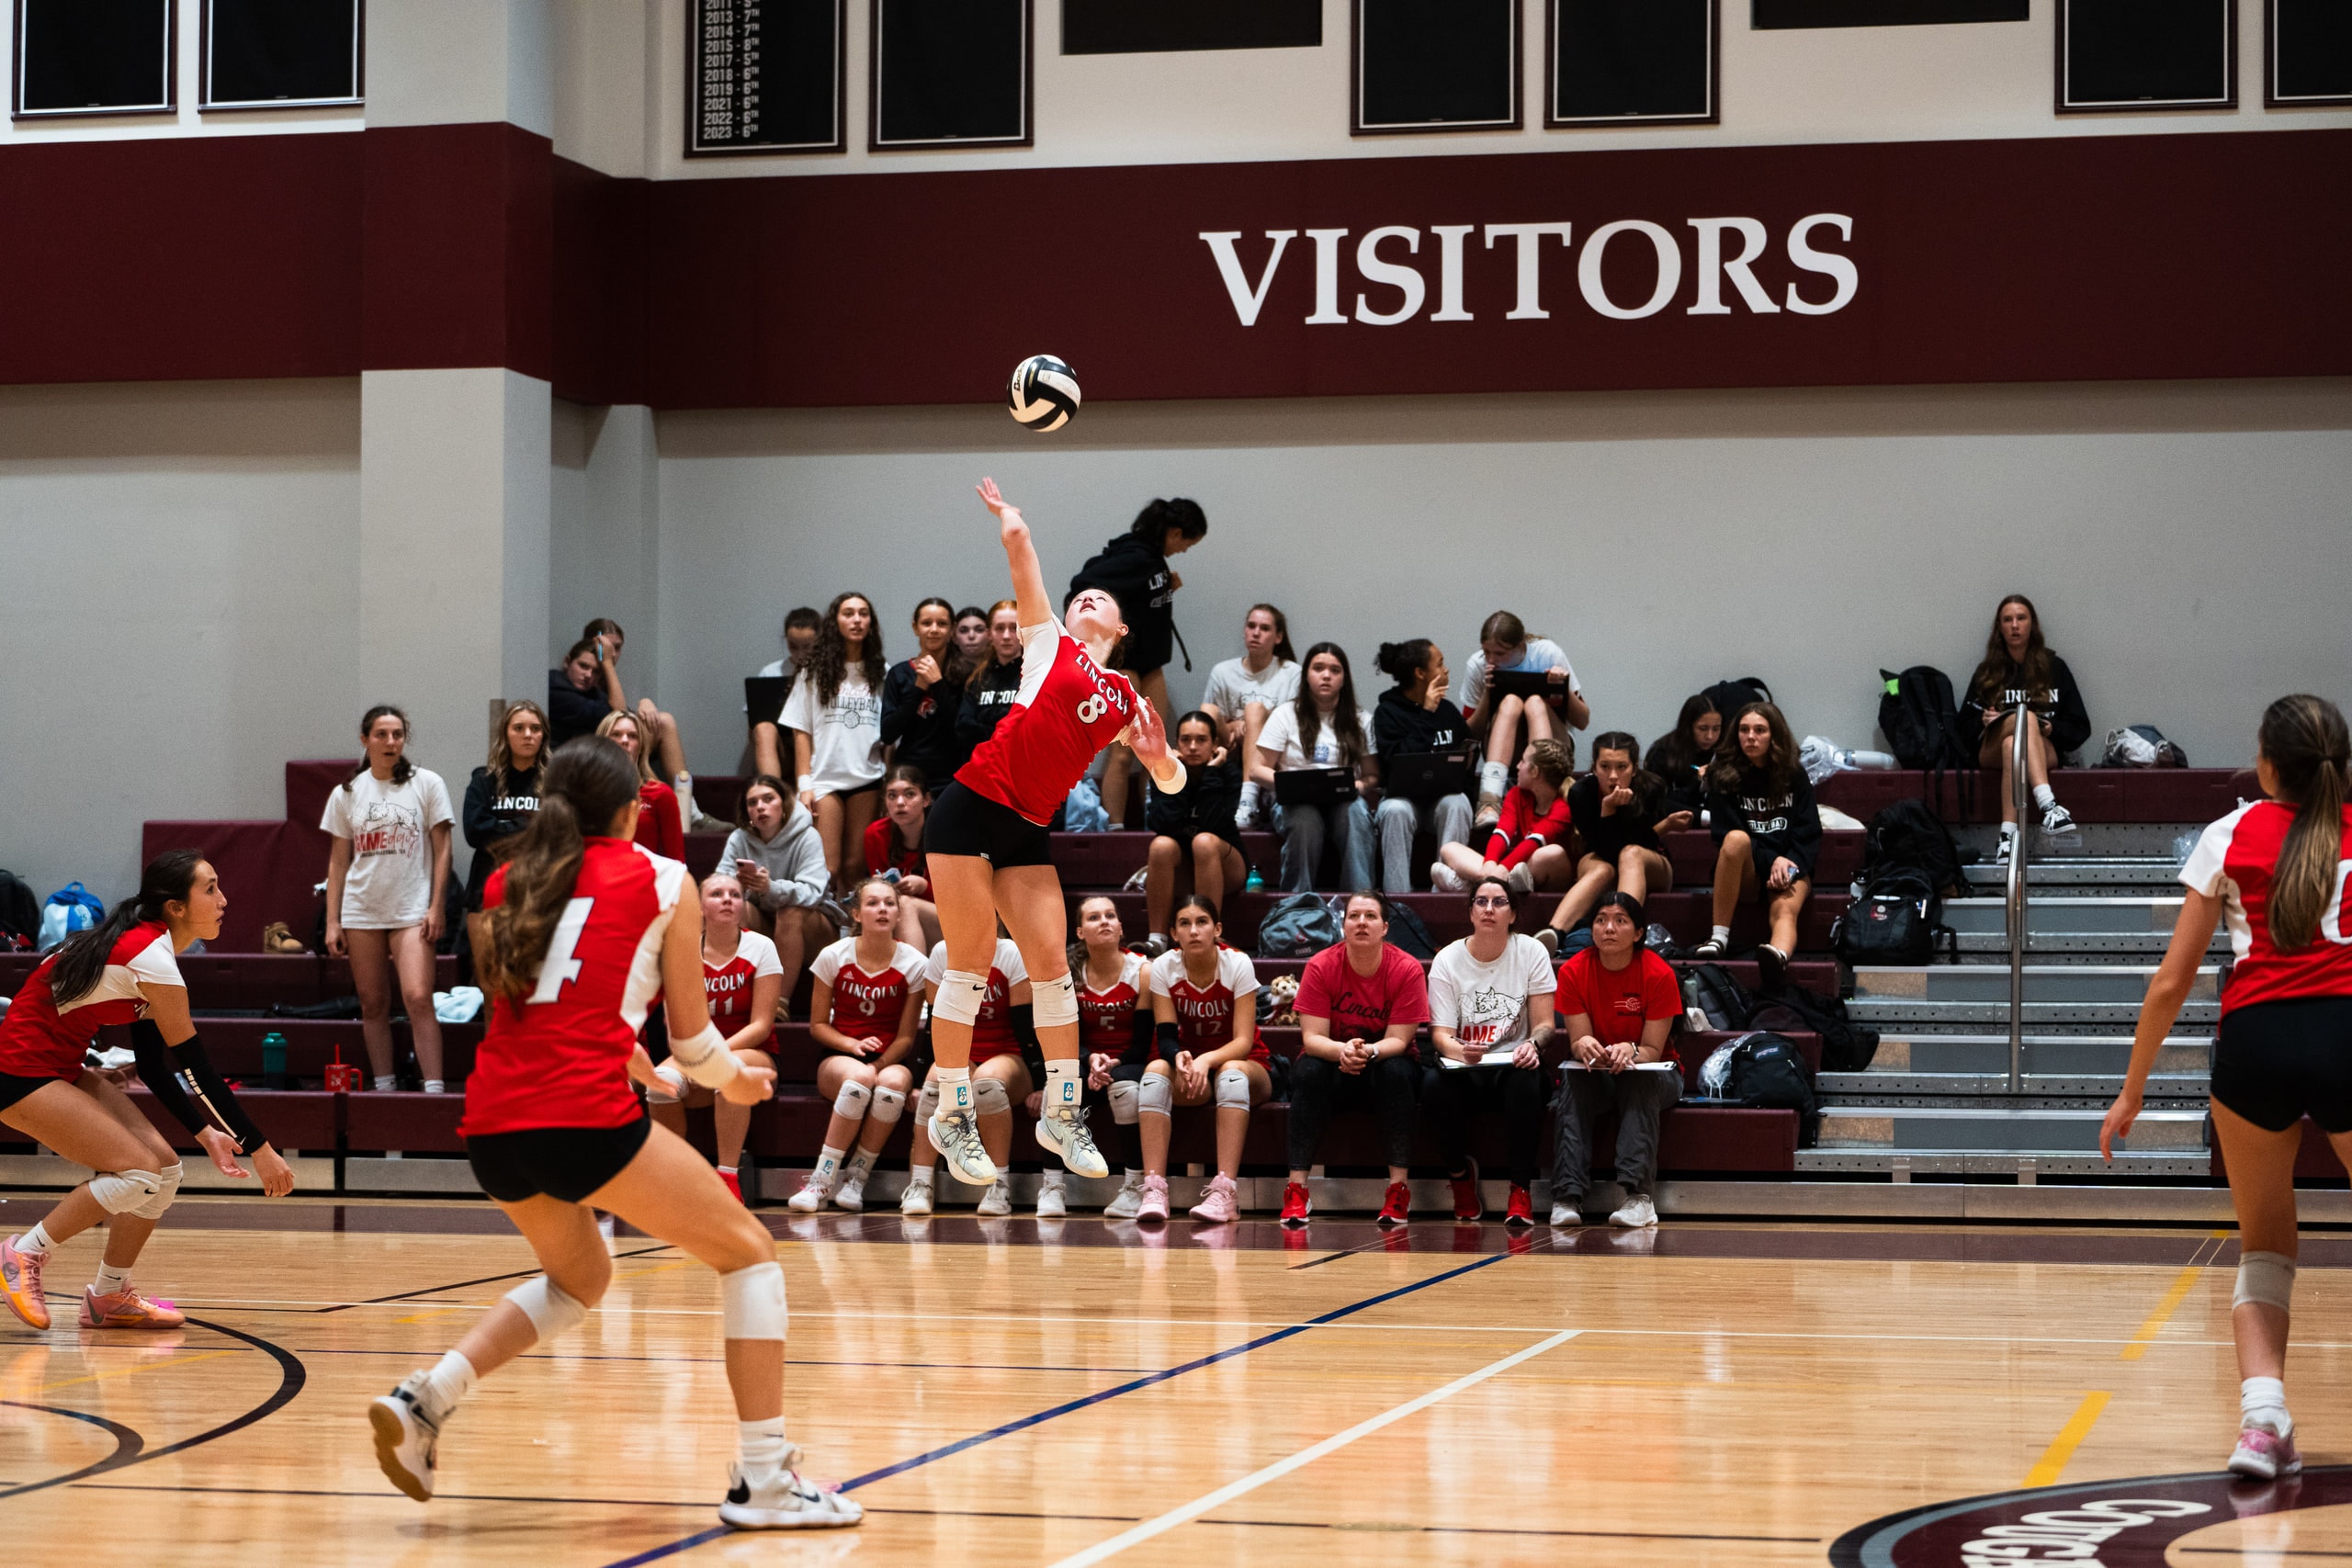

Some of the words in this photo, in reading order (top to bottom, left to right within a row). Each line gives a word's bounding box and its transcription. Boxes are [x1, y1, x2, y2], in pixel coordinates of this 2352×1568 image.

[706, 11, 733, 24] 2013
[744, 8, 760, 23] 7TH
[706, 26, 733, 39] 2014
[744, 23, 760, 37] 7TH
[706, 39, 733, 53] 2015
[744, 38, 760, 51] 8TH
[705, 54, 733, 68] 2017
[744, 51, 760, 66] 5TH
[705, 69, 733, 83] 2018
[743, 66, 760, 80] 6TH
[705, 83, 733, 96] 2019
[743, 81, 760, 95] 6TH
[705, 97, 732, 111] 2021
[743, 96, 760, 109] 6TH
[705, 111, 733, 126] 2022
[743, 109, 759, 124] 6TH
[704, 126, 733, 140] 2023
[742, 124, 759, 138] 6TH
[1199, 212, 1859, 326] VISITORS
[1077, 693, 1108, 724] 8
[707, 996, 733, 1017] 11
[859, 999, 876, 1016] 9
[1178, 998, 1229, 1018] LINCOLN
[1195, 1021, 1222, 1036] 12
